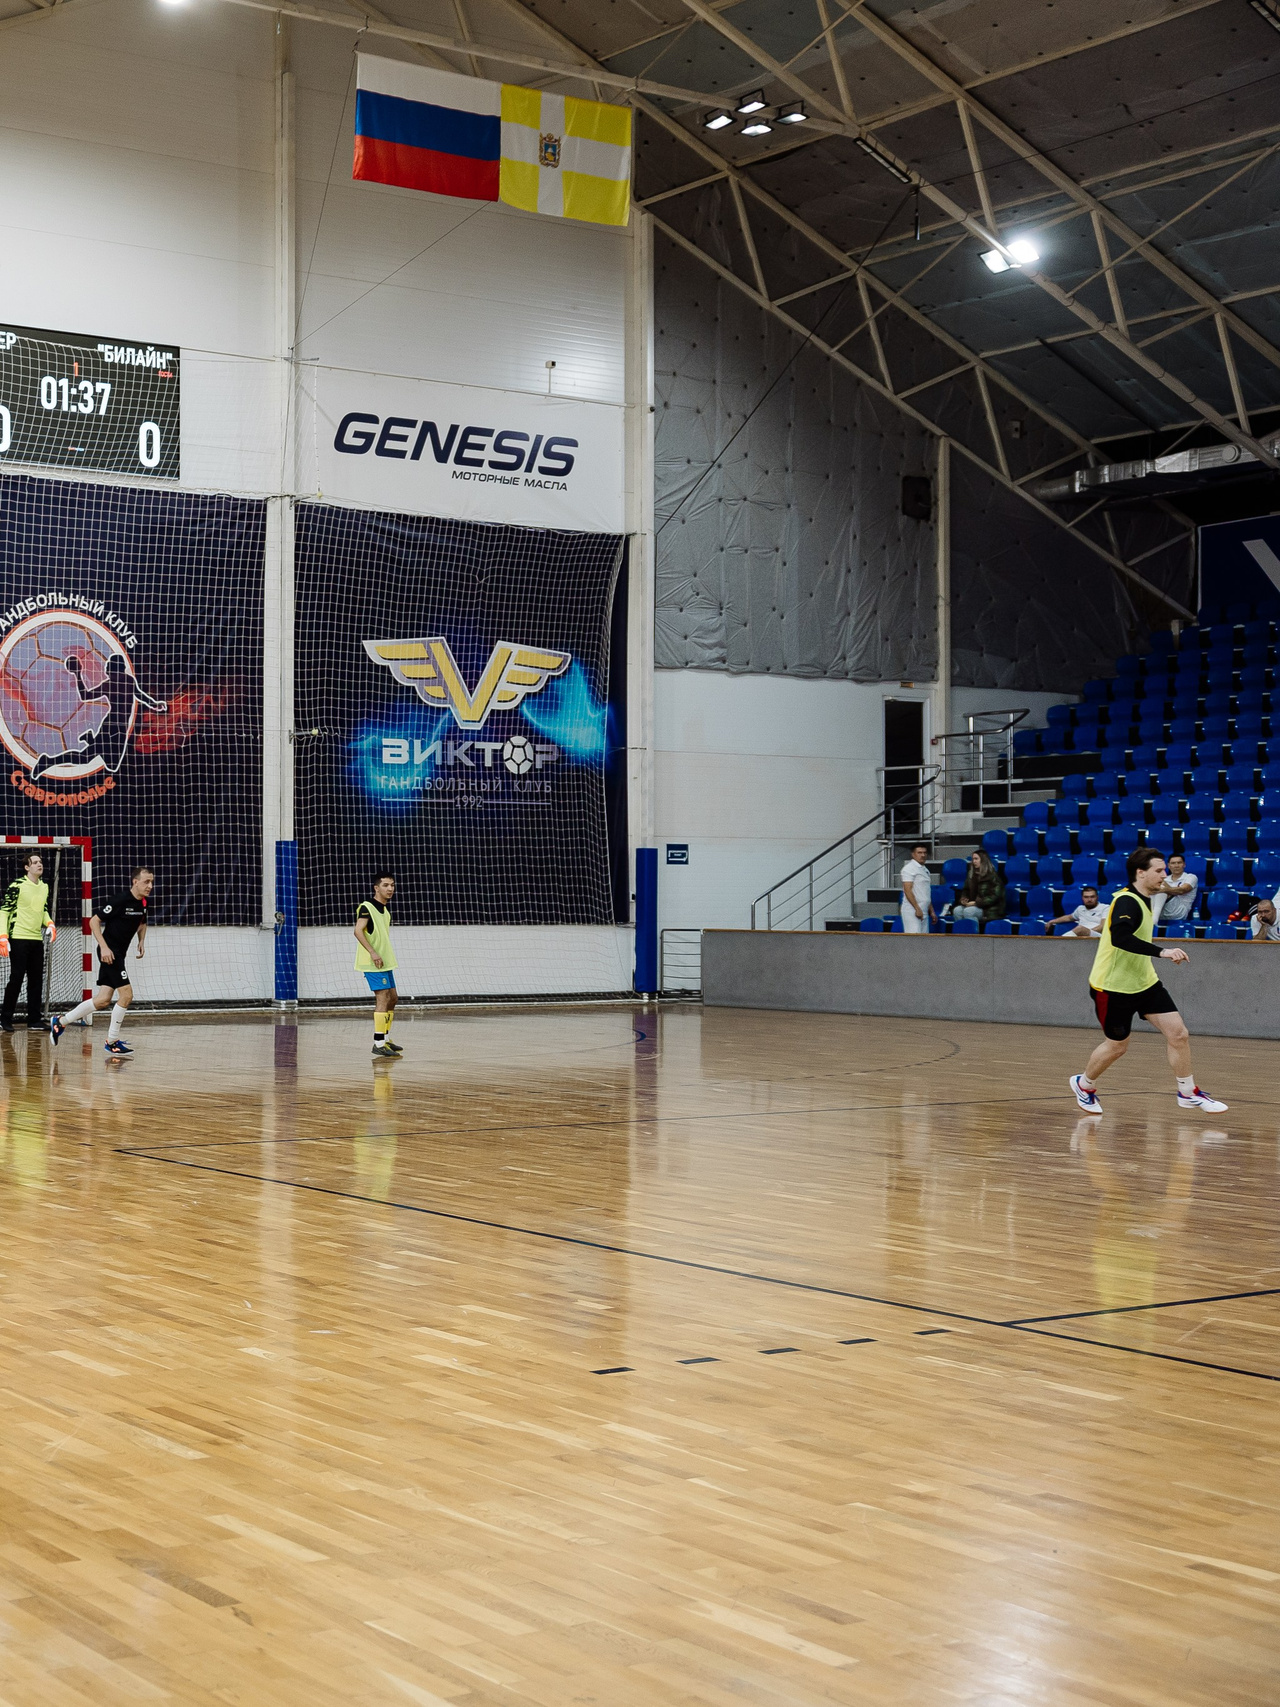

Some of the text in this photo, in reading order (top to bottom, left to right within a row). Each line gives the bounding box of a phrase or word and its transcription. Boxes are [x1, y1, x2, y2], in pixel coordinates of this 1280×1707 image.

[40, 375, 111, 416] 01:37
[138, 421, 161, 468] 0
[333, 411, 579, 477] GENESIS
[452, 470, 568, 492] МОТОРНЫЕ МАСЛА
[105, 612, 139, 649] КЛУБ
[381, 735, 560, 775] ВИКТОР
[380, 775, 552, 793] ГАНДБОЛЬНЫЙ КЛУБ
[454, 795, 484, 809] 1992
[103, 905, 112, 914] 9
[121, 970, 128, 979] 9
